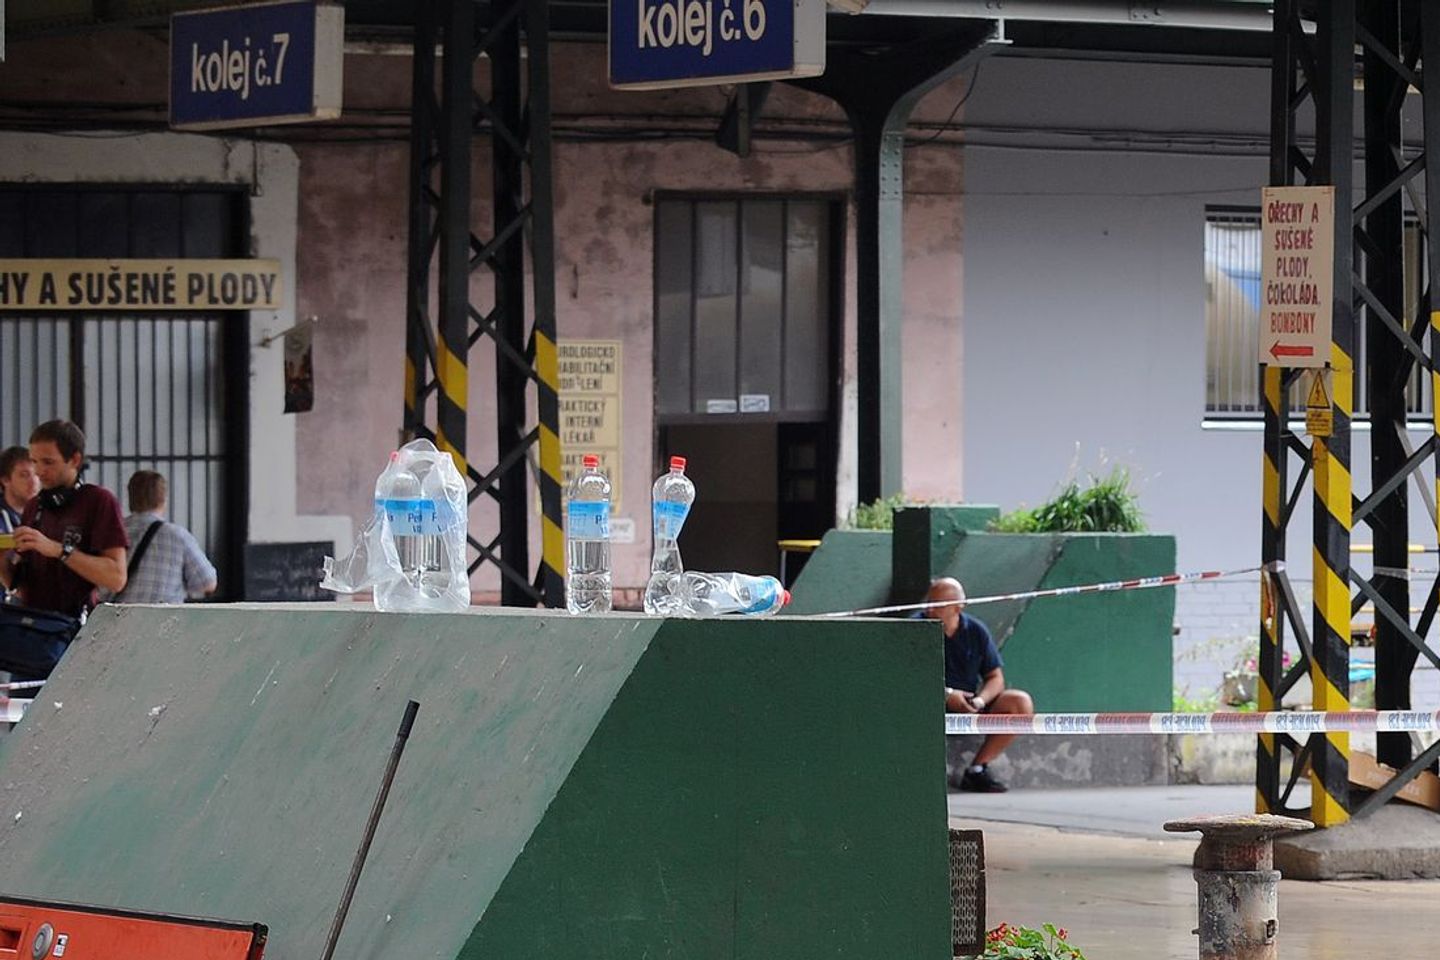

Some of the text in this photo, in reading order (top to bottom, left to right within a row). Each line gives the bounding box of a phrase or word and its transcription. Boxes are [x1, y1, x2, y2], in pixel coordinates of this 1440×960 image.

[638, 0, 713, 56] kolej
[191, 37, 250, 100] kolej
[1268, 200, 1319, 224] OŘECHY A
[1275, 226, 1313, 251] SUŠENÉ
[39, 273, 57, 305] A
[67, 266, 176, 305] SUŠENÉ
[188, 273, 277, 305] PLODY
[1270, 312, 1316, 334] BONBONY
